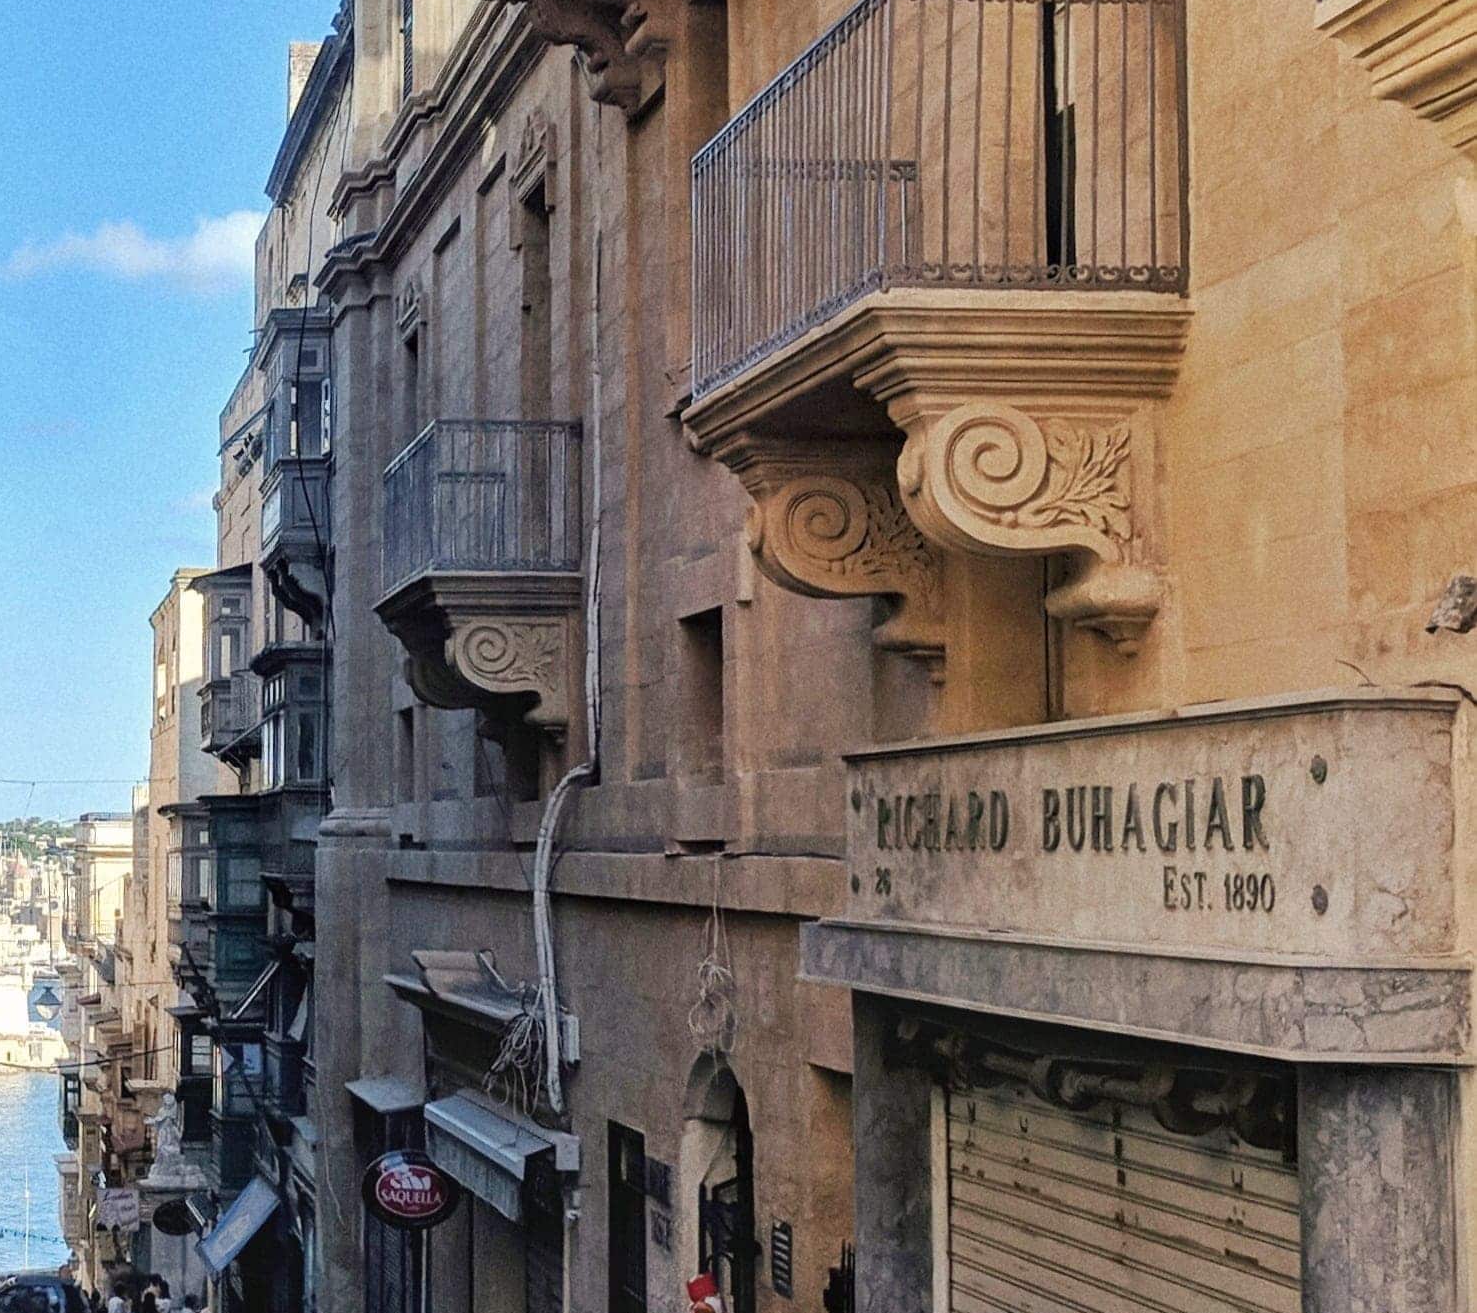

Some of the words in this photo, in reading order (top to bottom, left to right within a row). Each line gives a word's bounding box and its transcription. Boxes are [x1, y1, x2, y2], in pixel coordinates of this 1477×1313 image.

[876, 787, 1010, 852] RICHARD
[1042, 773, 1271, 854] BUHAGIAR
[1224, 871, 1275, 913] 1890
[381, 1188, 442, 1206] SAQUELLA
